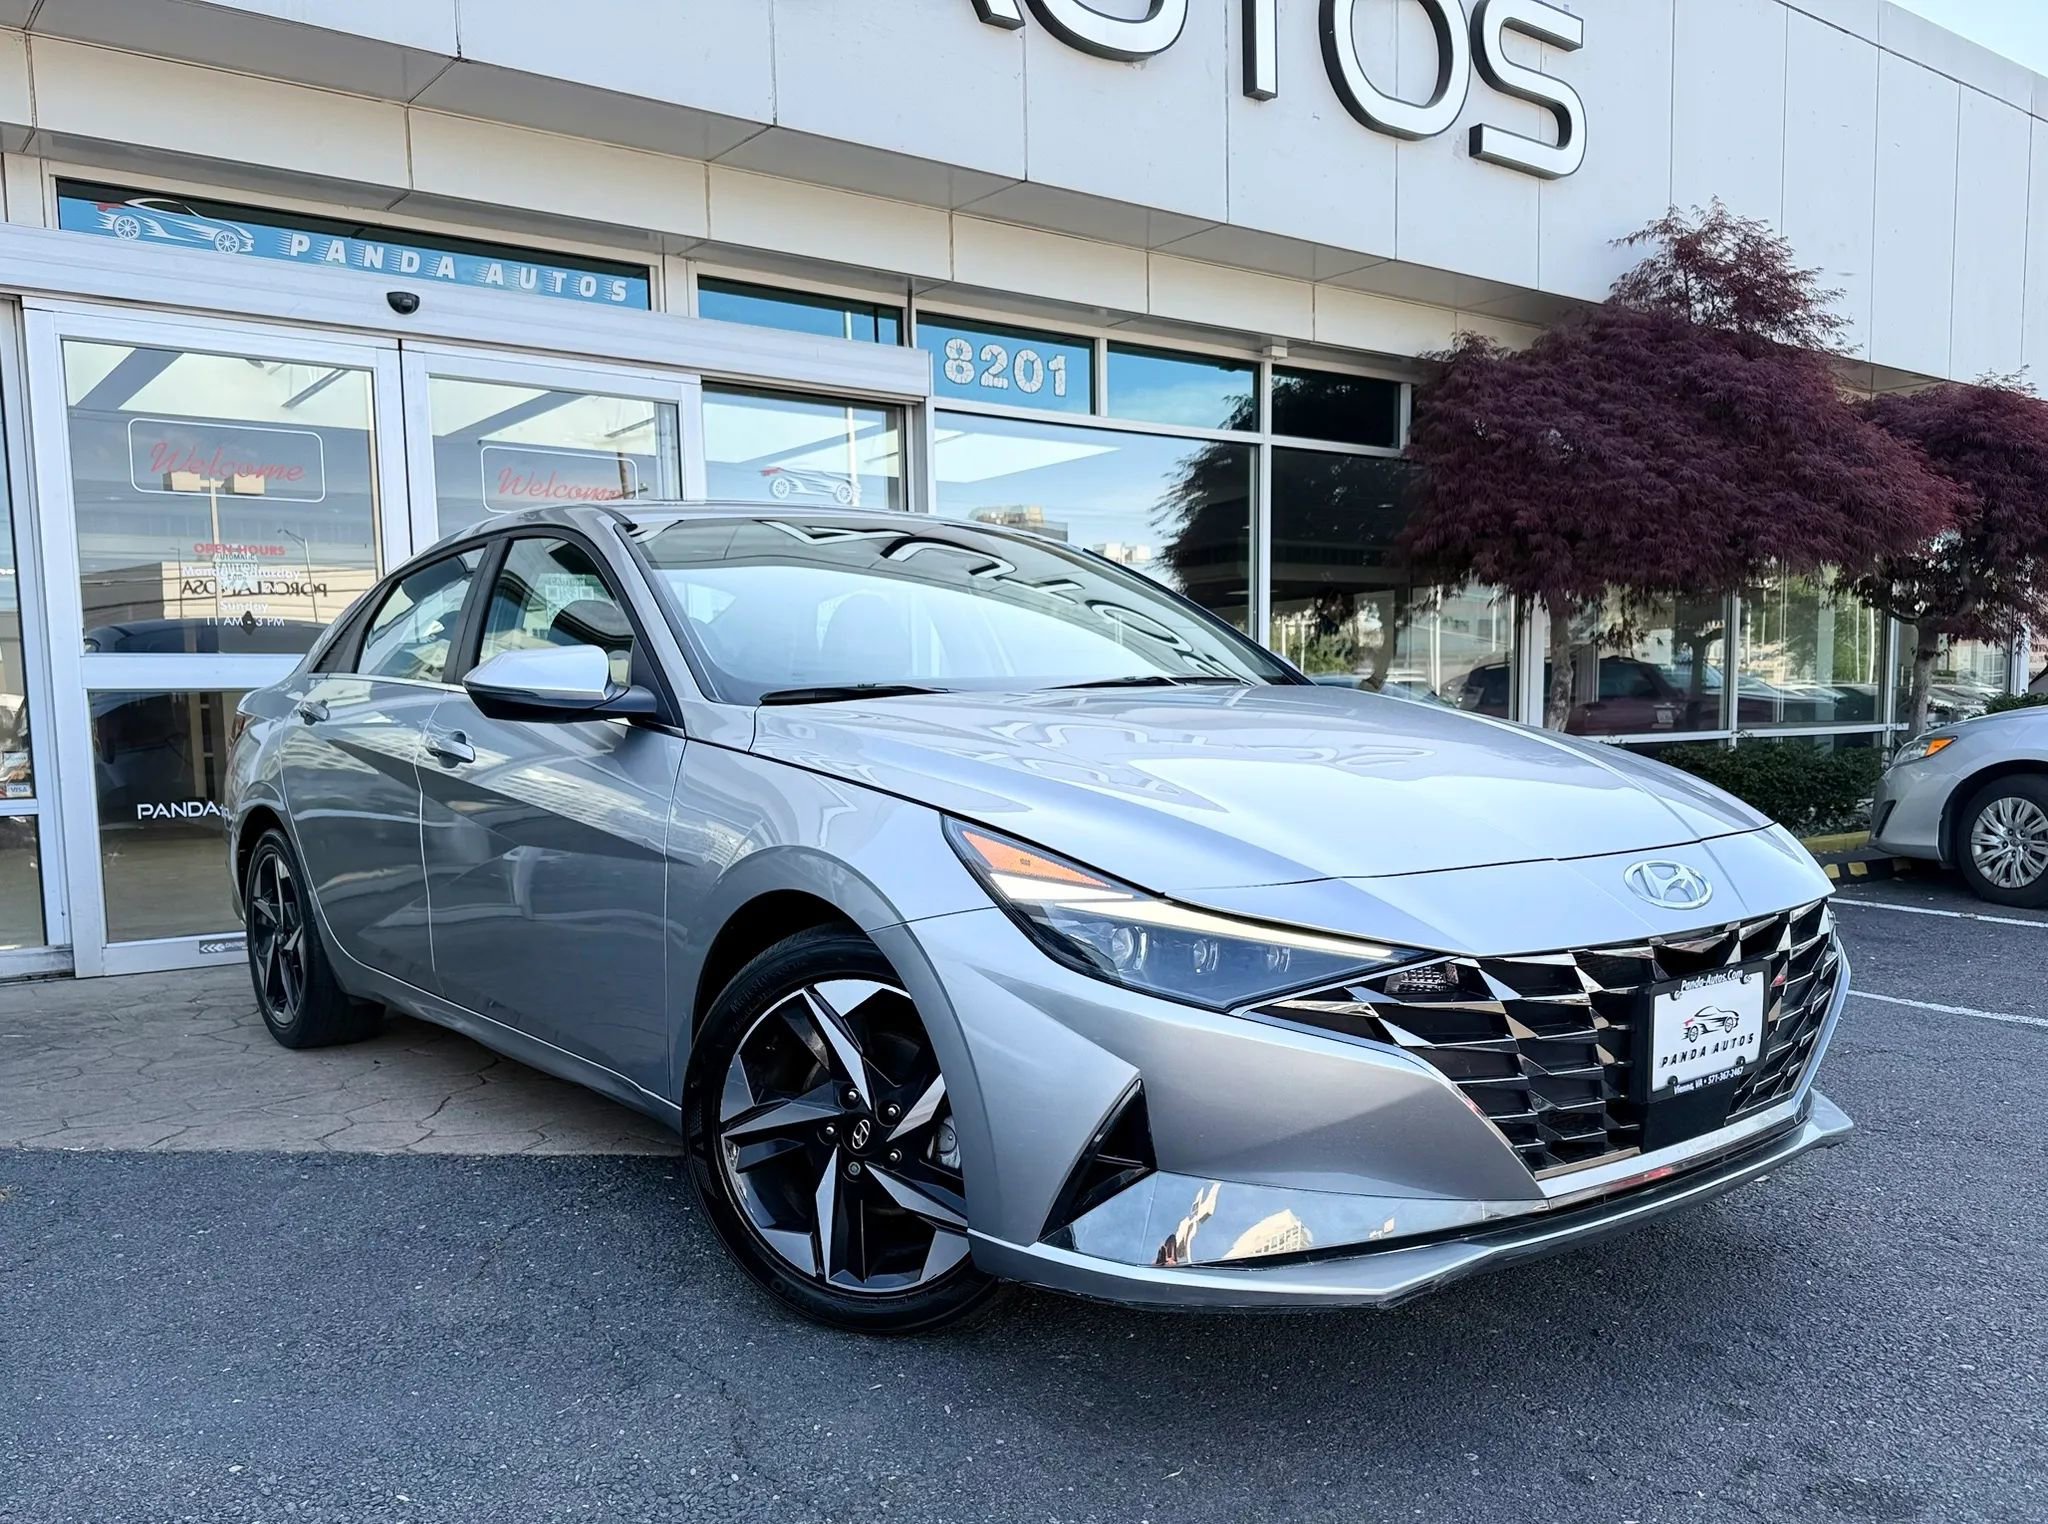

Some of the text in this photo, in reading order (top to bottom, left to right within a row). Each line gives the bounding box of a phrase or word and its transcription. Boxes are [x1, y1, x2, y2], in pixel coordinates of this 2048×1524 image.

[288, 232, 627, 303] PANDA AUTOS
[943, 337, 1067, 398] 8201
[149, 441, 306, 483] Welcome
[498, 466, 623, 501] Welcome
[193, 543, 286, 556] OPEN HOURS
[206, 617, 218, 626] 11
[223, 617, 244, 626] AM
[255, 617, 263, 627] 3
[267, 617, 285, 627] PM
[220, 602, 269, 612] Sunday
[136, 801, 221, 820] PANDA
[1660, 1033, 1755, 1068] PANDA AUTOS
